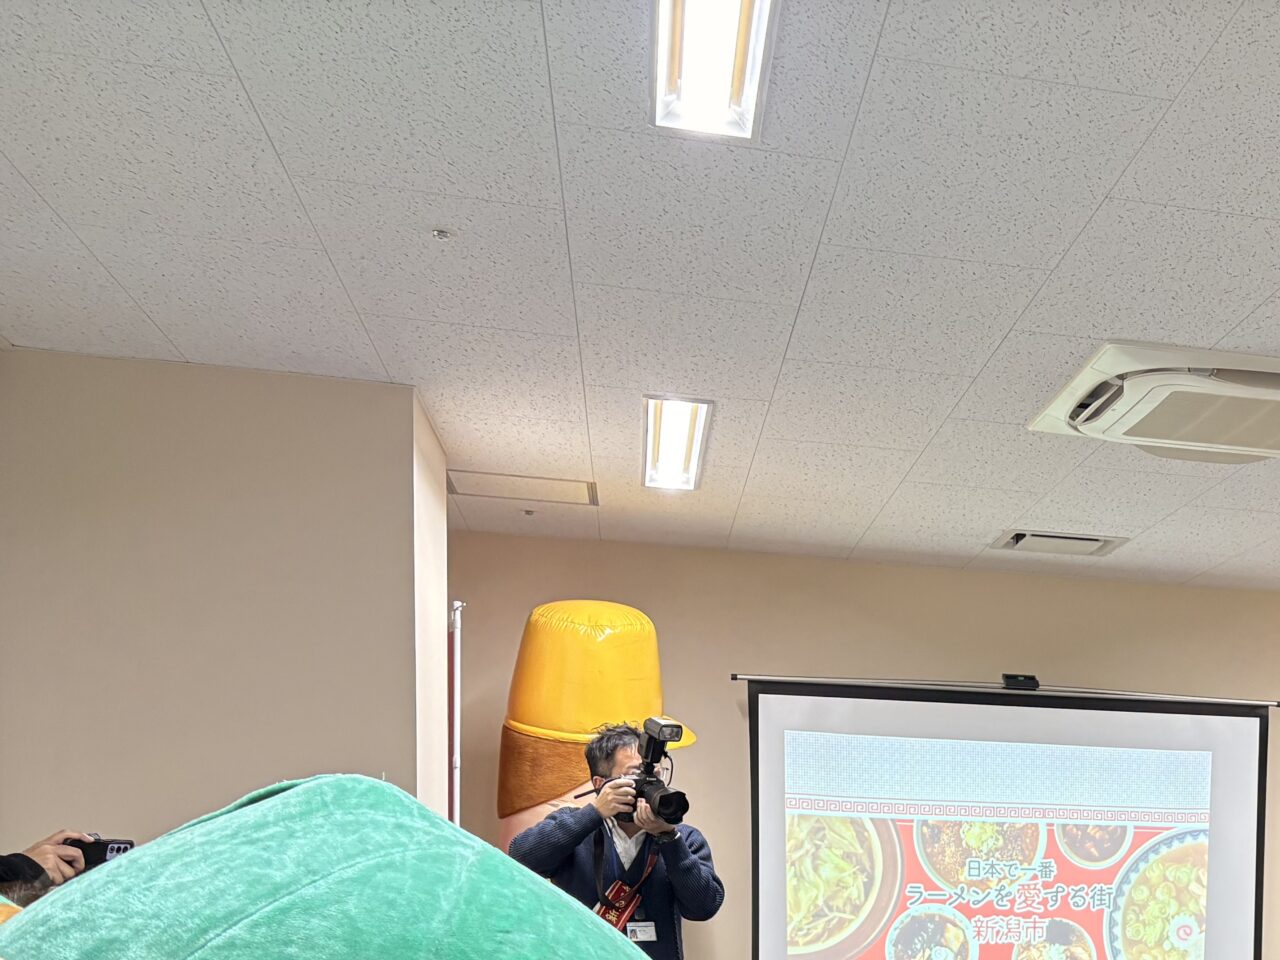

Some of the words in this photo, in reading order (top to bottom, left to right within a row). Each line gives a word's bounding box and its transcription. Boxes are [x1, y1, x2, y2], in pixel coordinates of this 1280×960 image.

[967, 860, 1056, 879] 日本で一番
[907, 882, 1114, 911] ラーメンを愛する街
[972, 917, 1047, 943] 新潟市
